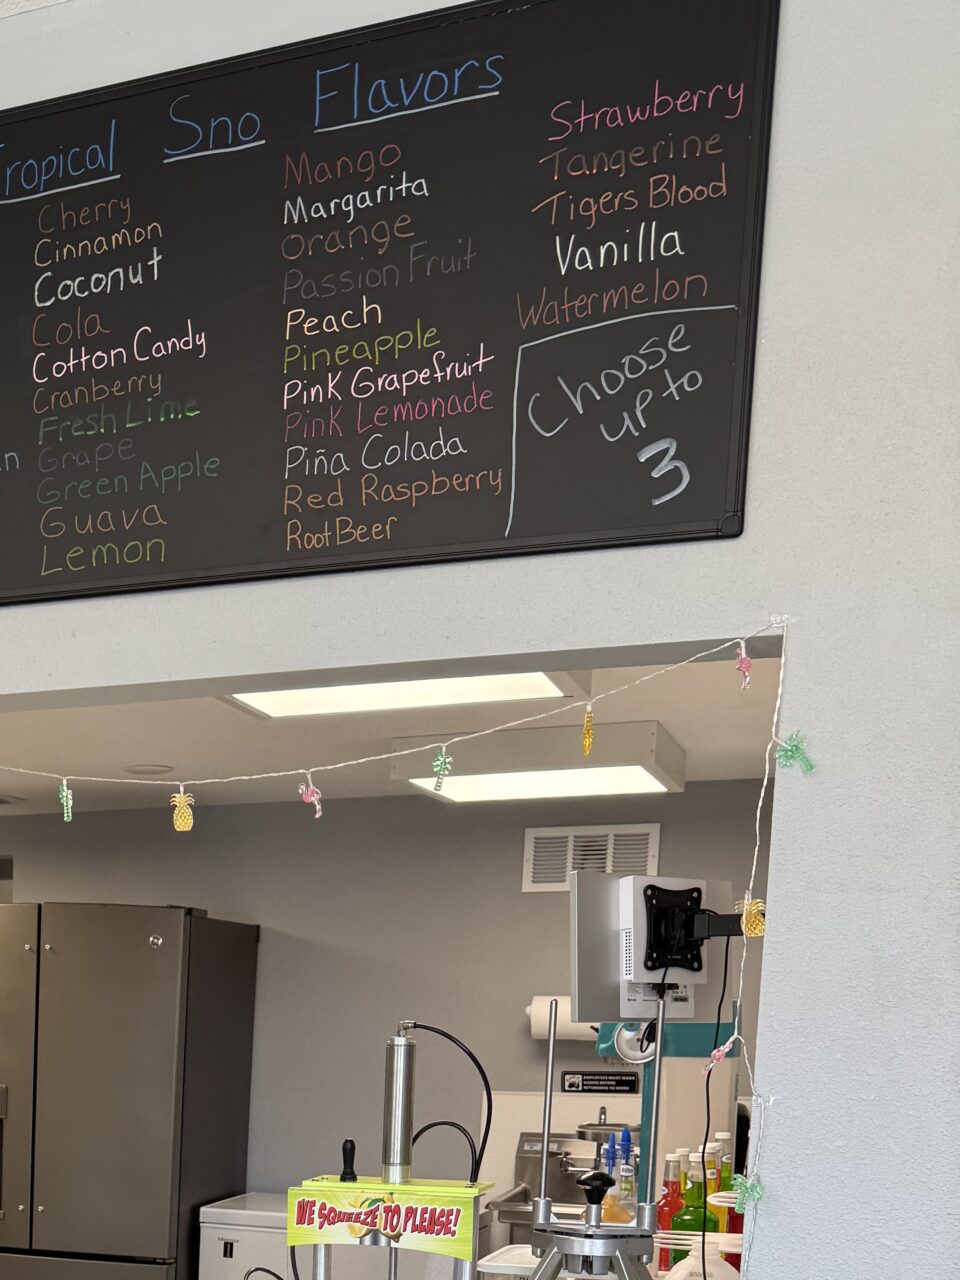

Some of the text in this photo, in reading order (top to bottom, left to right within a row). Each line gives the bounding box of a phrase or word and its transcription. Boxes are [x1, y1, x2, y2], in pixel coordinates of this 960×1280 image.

[163, 95, 261, 155] Sno
[313, 55, 504, 127] Flavors
[547, 79, 745, 141] Strawberry
[283, 144, 401, 189] Mango
[539, 132, 724, 181] Tangerine
[38, 198, 131, 233] Cherry
[283, 171, 430, 225] Margarita
[531, 162, 727, 230] Tigers Blood
[34, 222, 163, 267] Cinnamon
[281, 214, 415, 260] Orange
[555, 220, 685, 276] Vanilla
[34, 247, 163, 308] Coconut
[282, 236, 477, 305] Passion Fruit
[285, 295, 382, 341] Peach
[516, 268, 708, 330] Watermelon
[32, 306, 110, 347] Cola
[32, 318, 207, 383] Cotton Candy
[283, 317, 441, 374] Pineapple
[33, 373, 162, 414] Cranberry
[351, 342, 495, 398] Grapefruit
[528, 323, 692, 437] Choose
[38, 397, 201, 445] Fresh Lime
[357, 380, 494, 434] Lemonade
[600, 368, 703, 442] up to
[37, 450, 220, 504] Green Apple
[38, 438, 136, 473] Grape
[285, 426, 468, 480] Piña Colada
[636, 437, 691, 506] 3
[283, 468, 503, 516] Red Raspberry
[40, 503, 168, 538] Guava
[41, 538, 166, 576] Lemon
[295, 1198, 462, 1238] WE SQUEEZE TO PLEASE!
